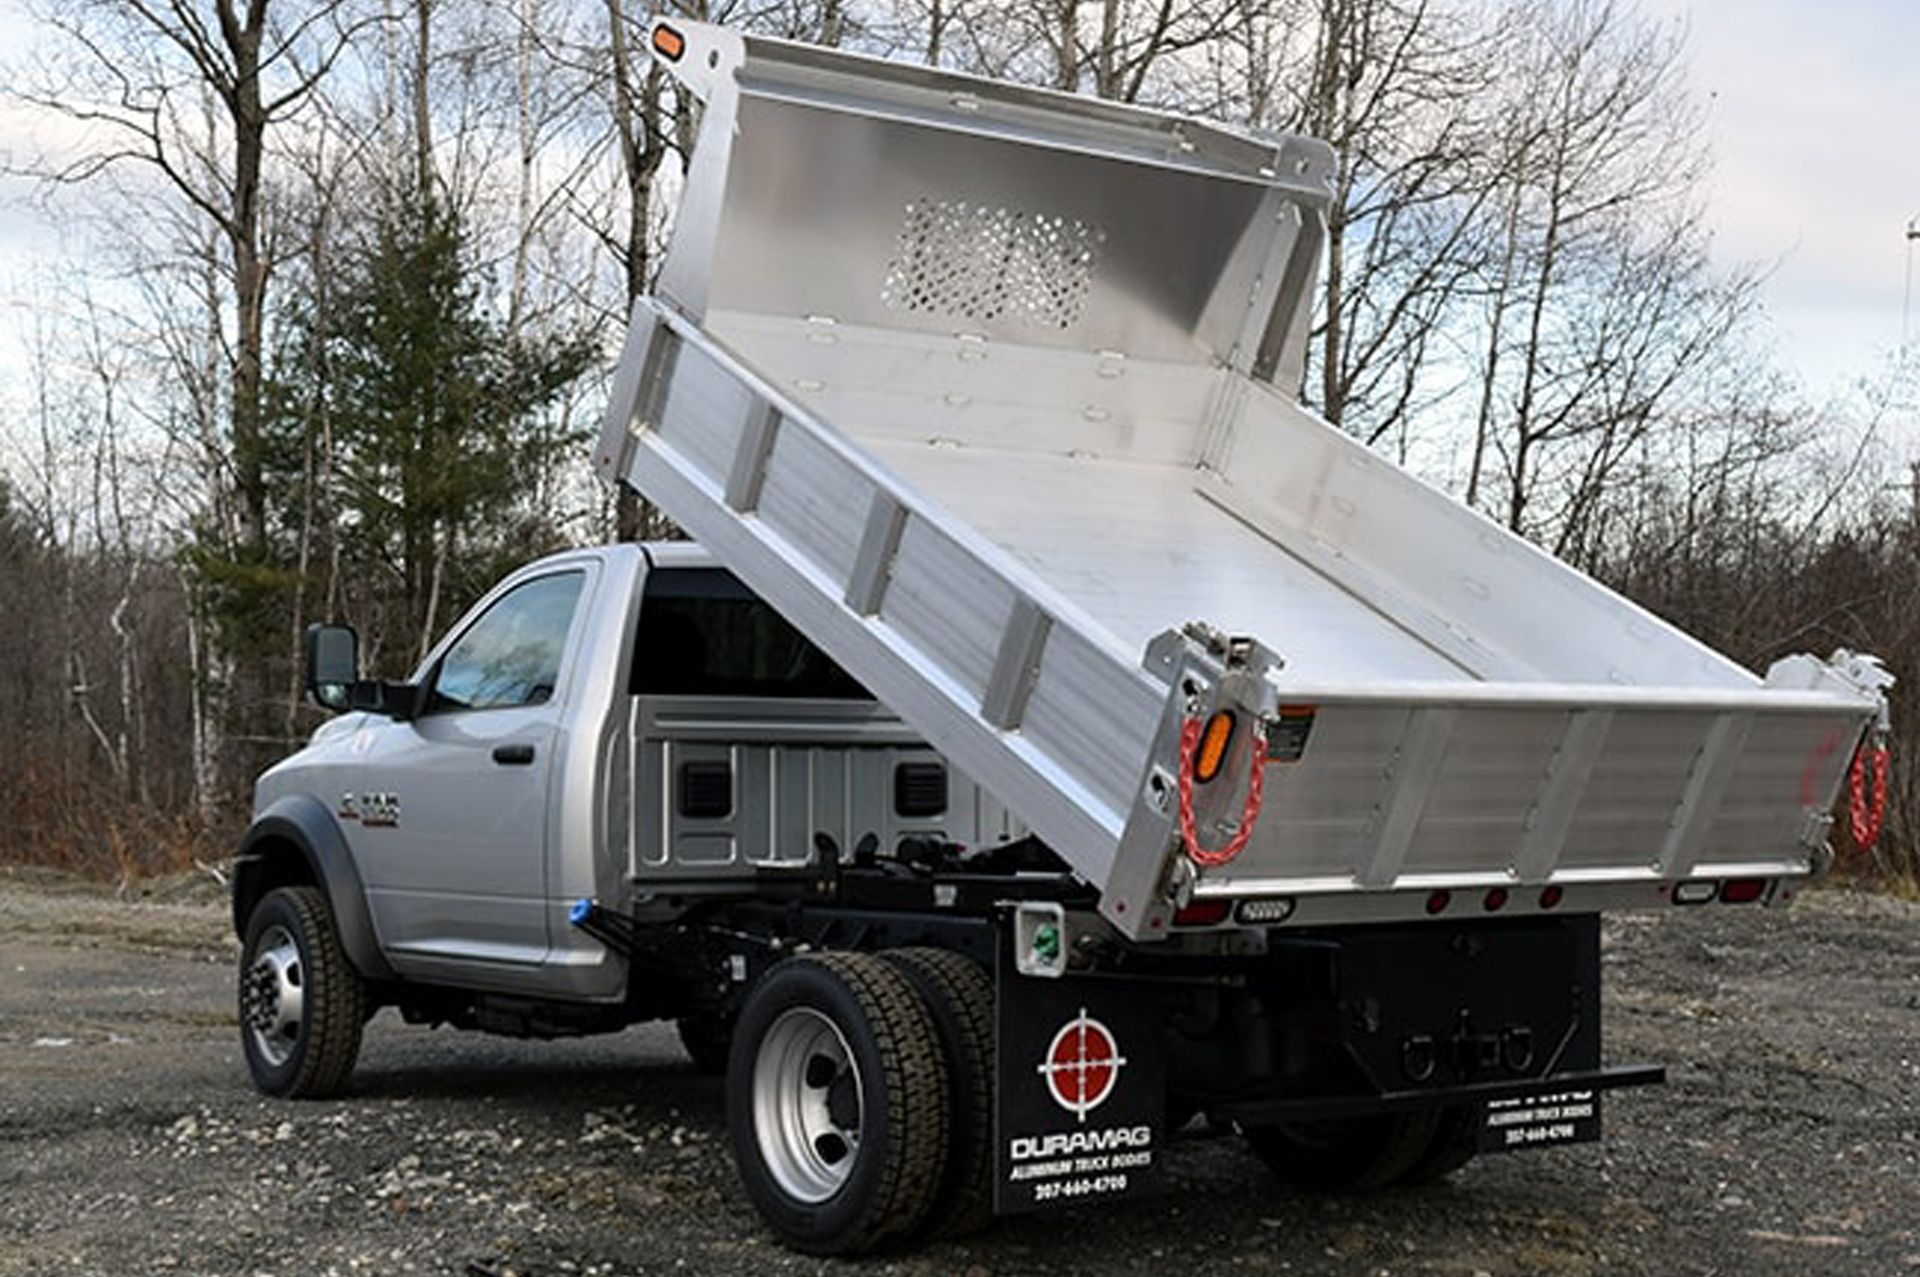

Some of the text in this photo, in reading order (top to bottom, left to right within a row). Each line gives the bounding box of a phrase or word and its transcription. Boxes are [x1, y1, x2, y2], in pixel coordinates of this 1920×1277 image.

[1010, 1126, 1151, 1160] DURAMAG
[1010, 1151, 1151, 1180] ALUMINUM TRUCK BODIES
